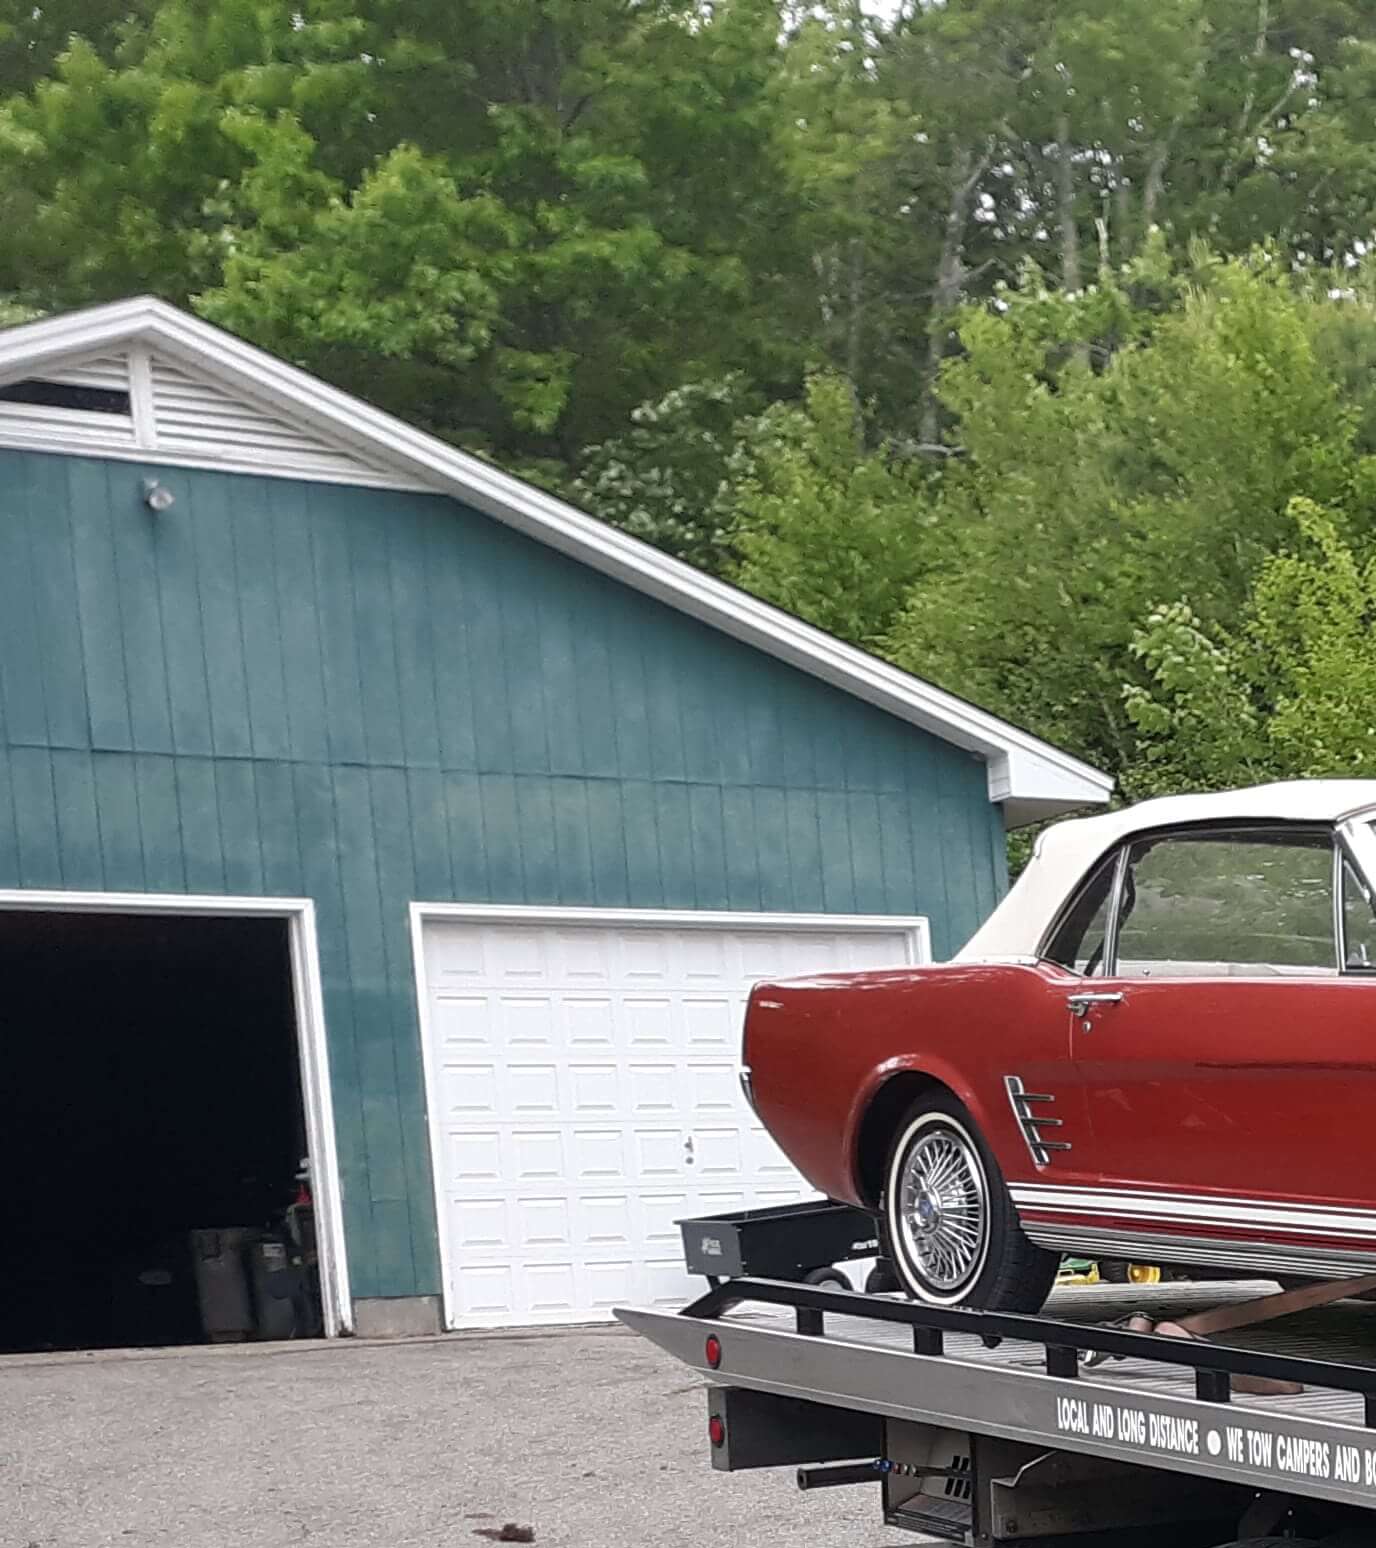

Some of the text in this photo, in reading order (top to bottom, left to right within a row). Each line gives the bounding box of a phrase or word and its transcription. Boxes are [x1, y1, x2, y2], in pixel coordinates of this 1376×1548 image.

[1057, 1397, 1090, 1434] LOCAL
[1092, 1403, 1114, 1438] AND
[1117, 1407, 1146, 1444] LONG
[1149, 1413, 1200, 1454] DISTANCE
[1226, 1426, 1244, 1463] WE
[1247, 1430, 1272, 1468] TOW
[1276, 1435, 1330, 1479] CAMPERS
[1334, 1445, 1360, 1483] AND
